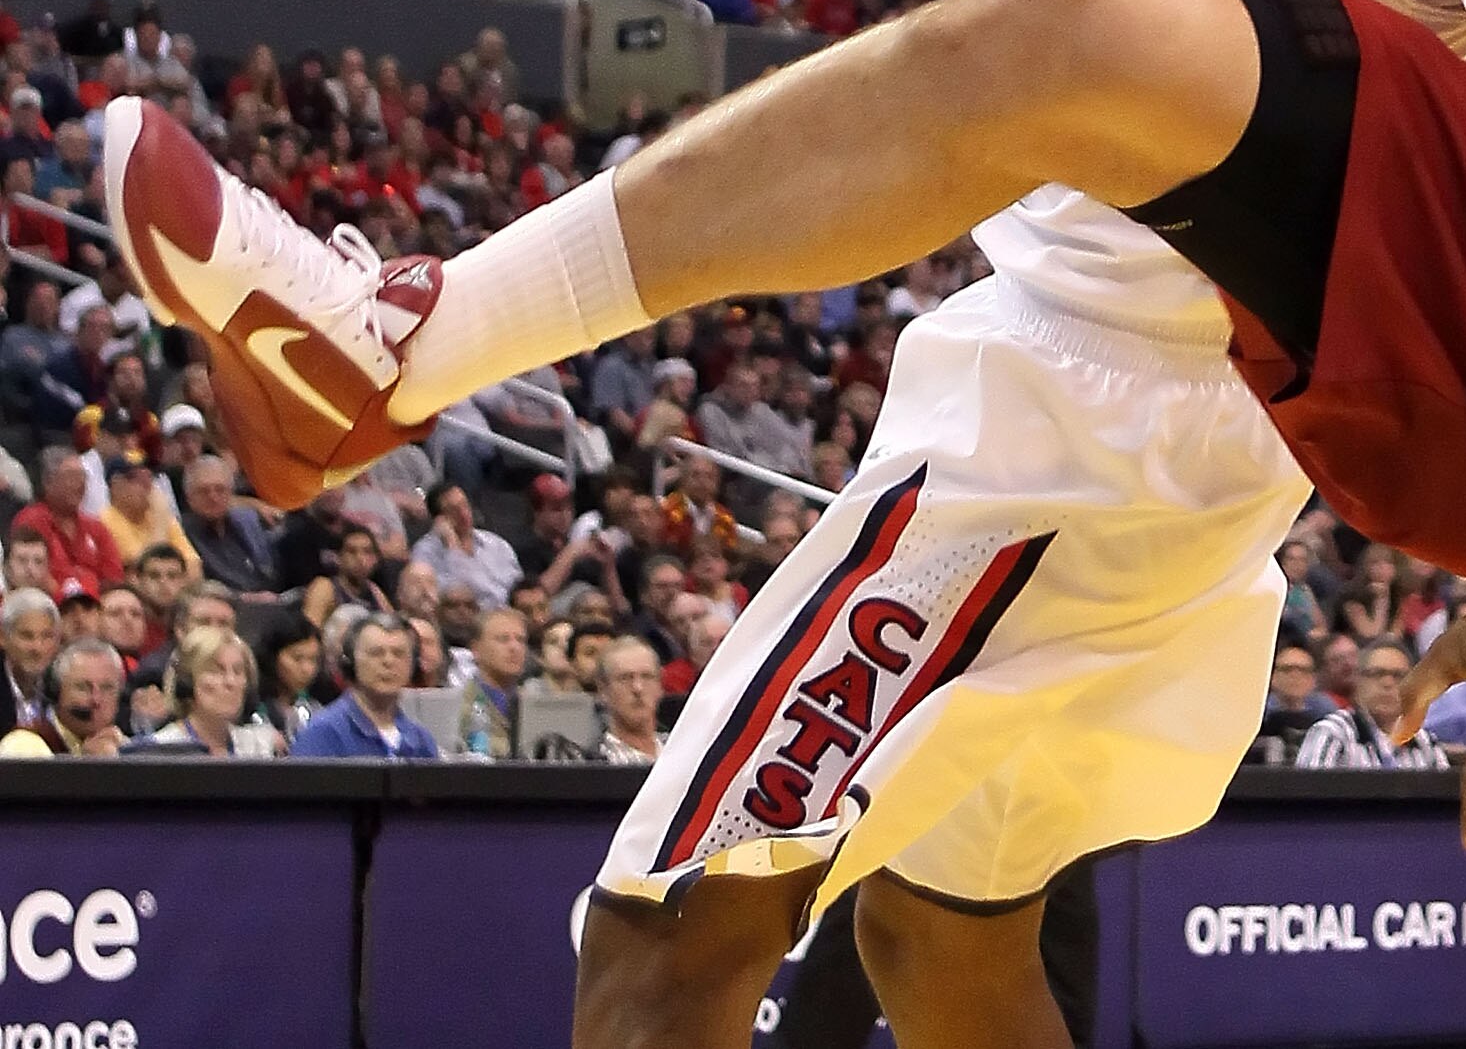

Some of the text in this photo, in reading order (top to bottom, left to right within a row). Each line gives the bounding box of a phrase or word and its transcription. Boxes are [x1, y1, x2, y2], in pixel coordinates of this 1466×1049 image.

[742, 597, 929, 830] CATS
[1185, 904, 1368, 956] OFFICIAL
[1372, 902, 1456, 949] CAR
